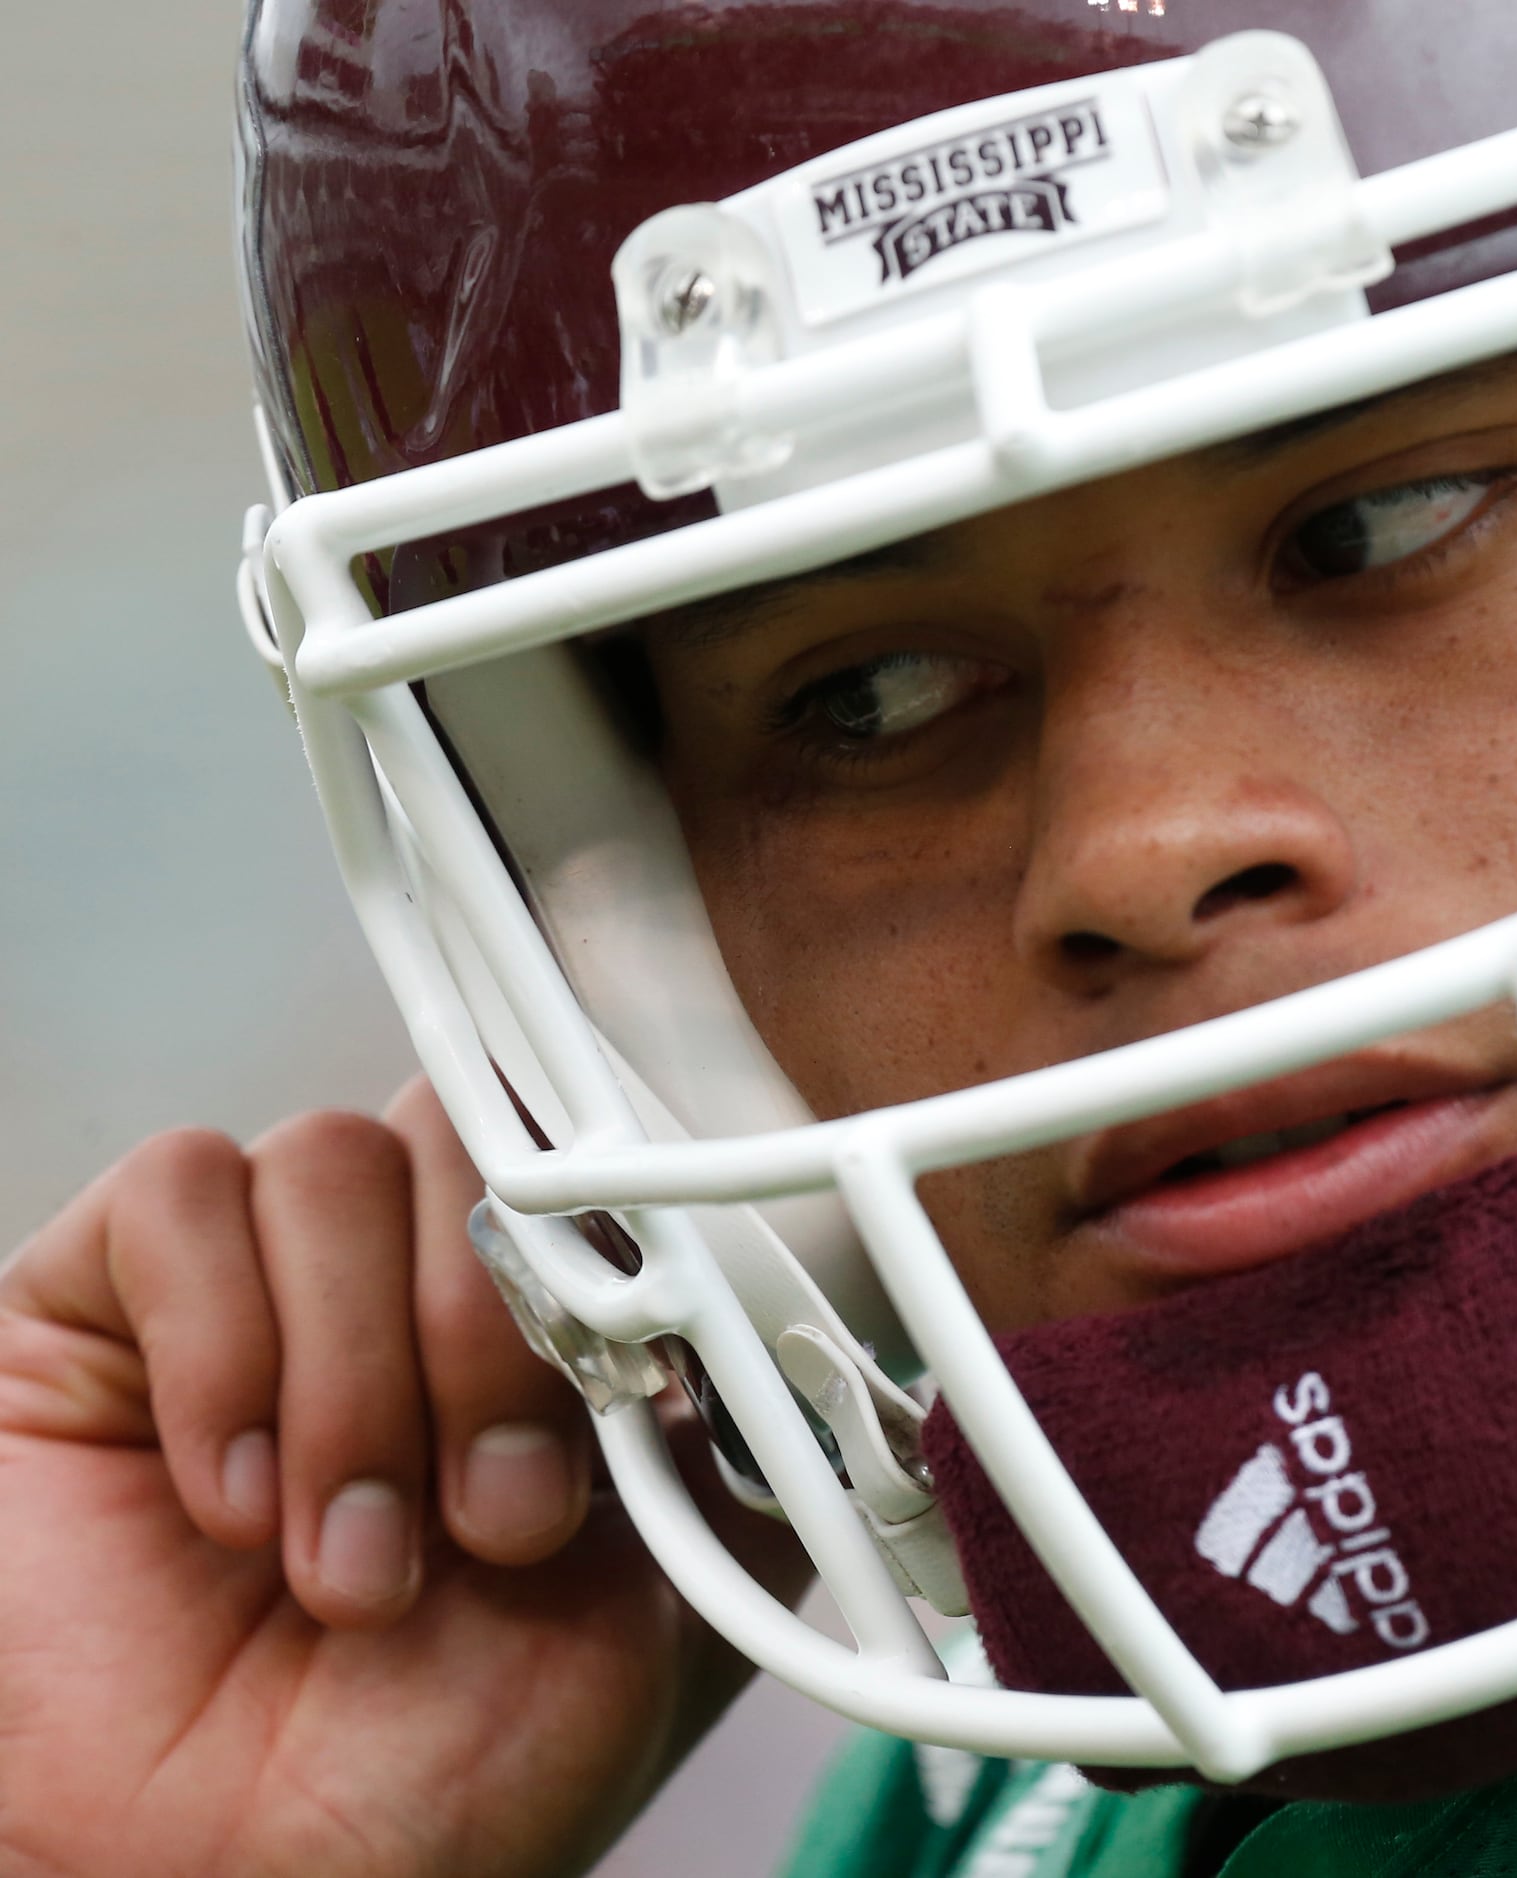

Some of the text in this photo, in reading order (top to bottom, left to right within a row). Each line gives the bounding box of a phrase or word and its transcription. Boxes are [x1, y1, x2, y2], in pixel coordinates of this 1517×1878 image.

[814, 110, 1107, 233] MISSISSIPPI
[901, 191, 1045, 266] STATE
[1273, 1371, 1431, 1648] adidas
